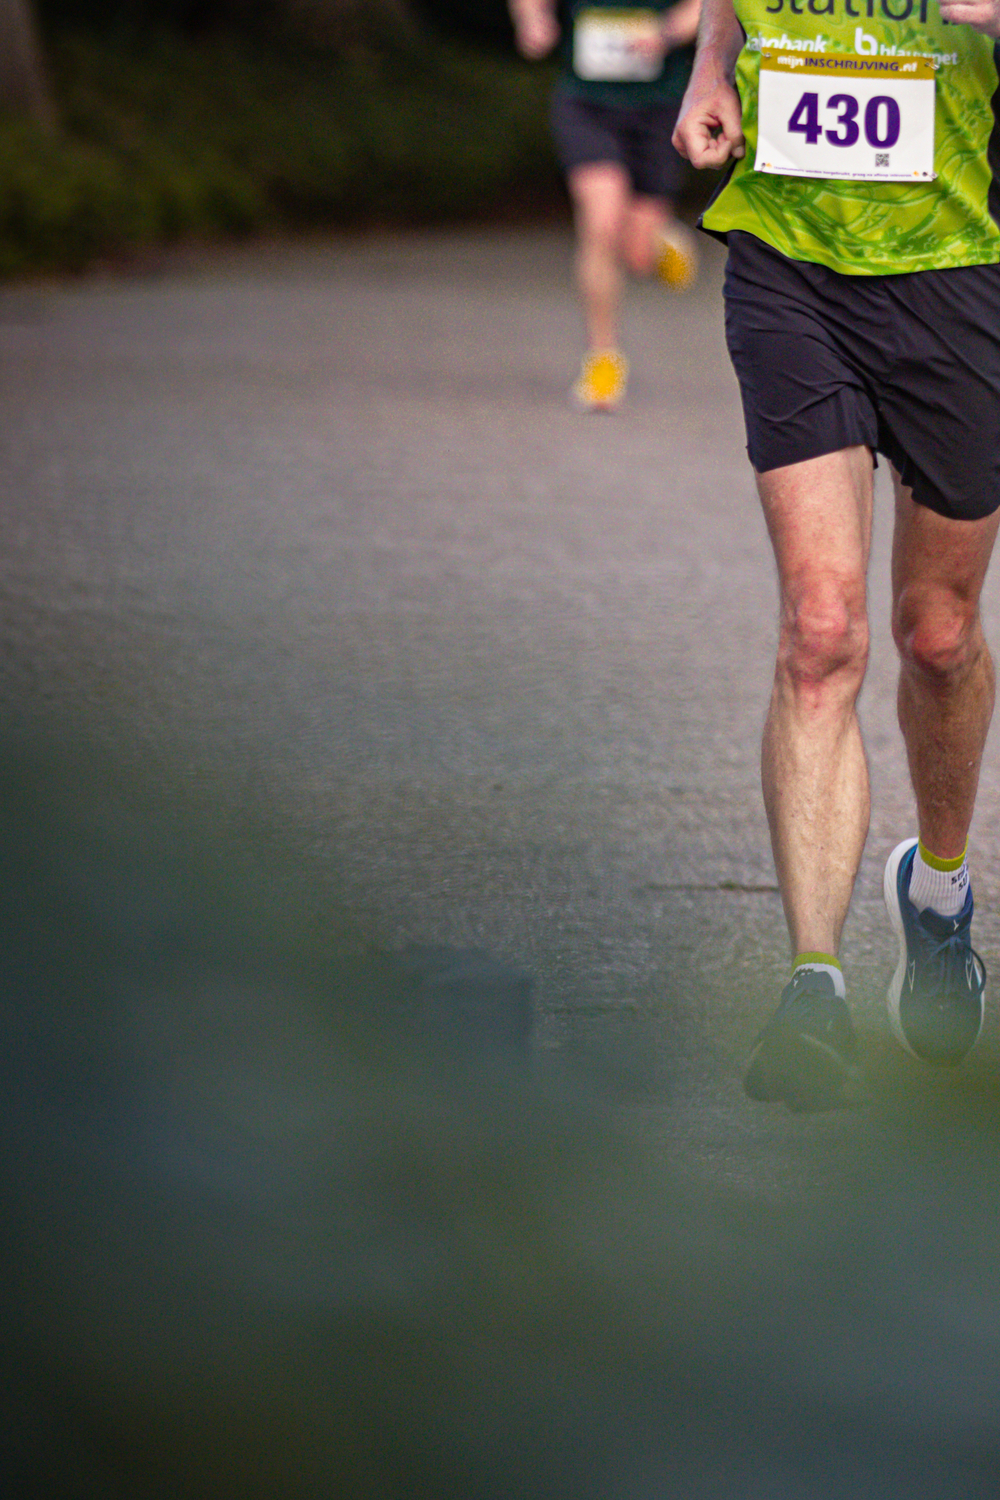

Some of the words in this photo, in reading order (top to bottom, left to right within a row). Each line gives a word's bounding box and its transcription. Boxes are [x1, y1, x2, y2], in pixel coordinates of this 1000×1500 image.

[747, 31, 828, 53] abobank
[777, 55, 918, 73] mijnINSCHRIJVING.nl
[787, 92, 901, 149] 430
